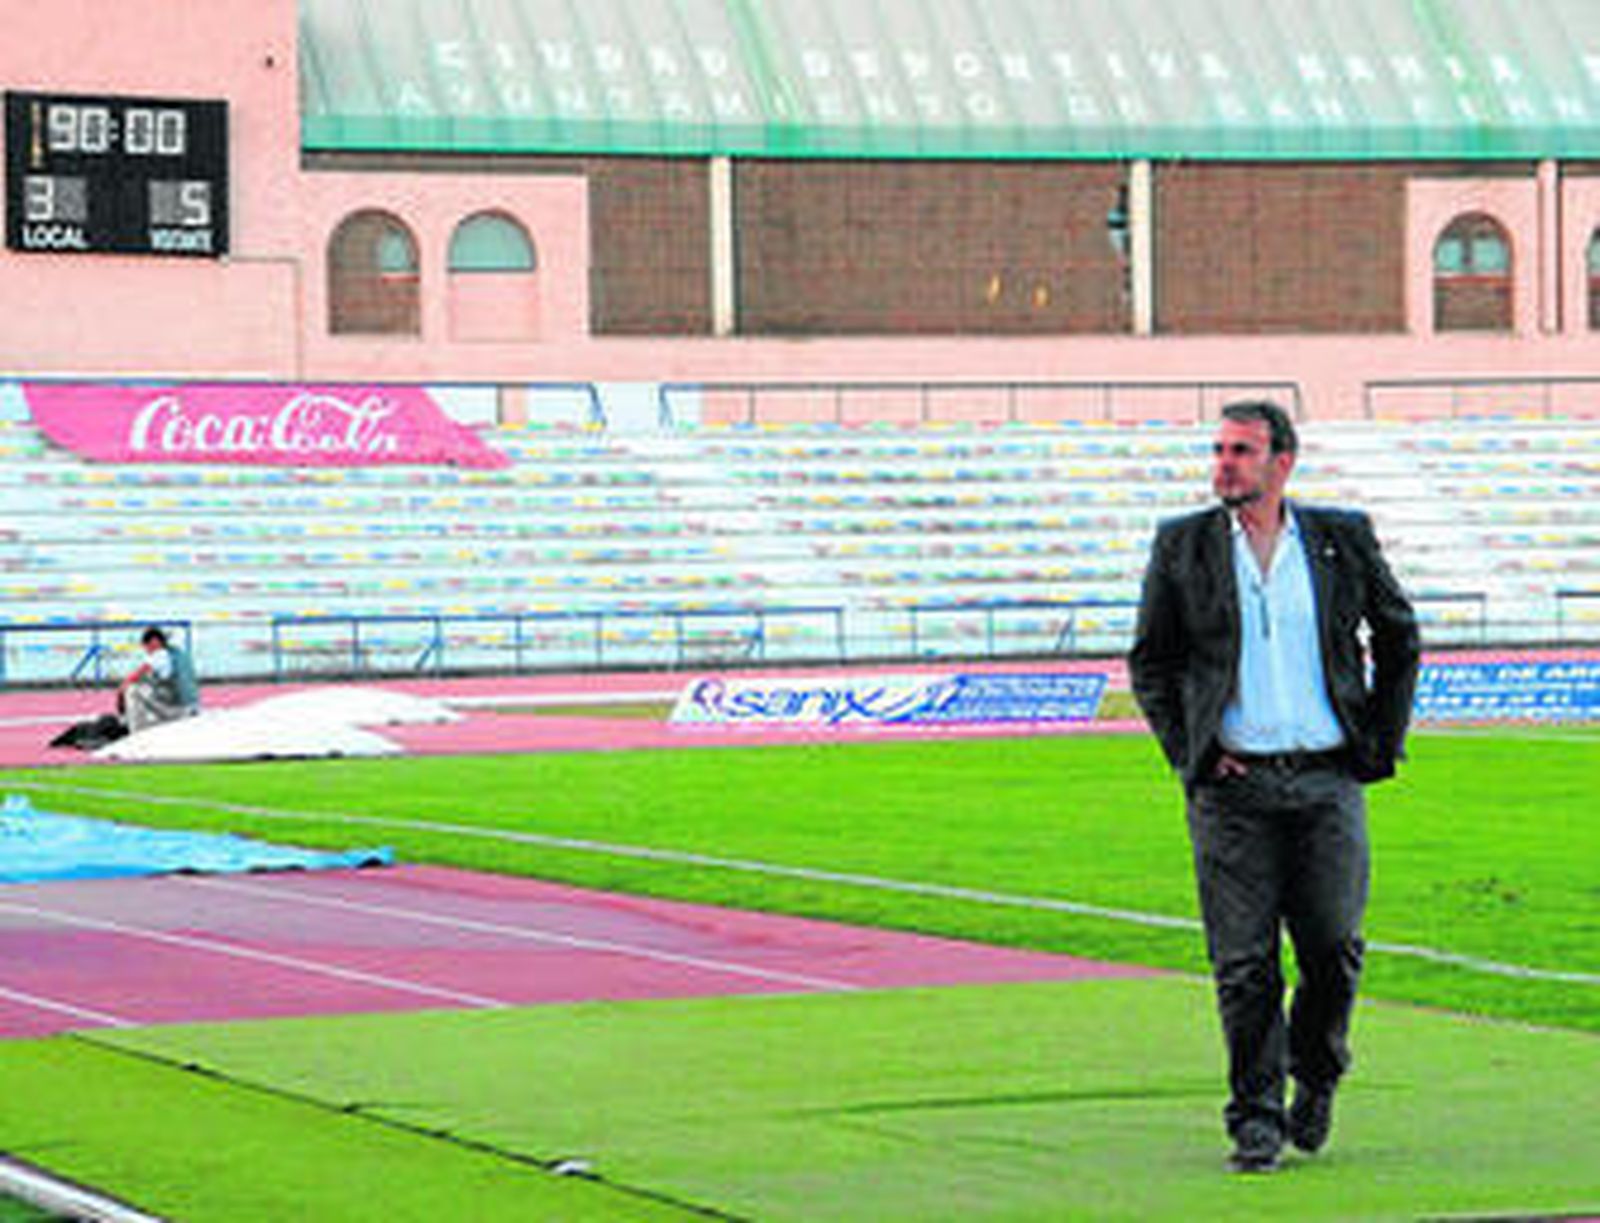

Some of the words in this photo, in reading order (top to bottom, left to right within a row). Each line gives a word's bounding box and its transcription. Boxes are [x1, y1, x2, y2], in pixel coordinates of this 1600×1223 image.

[48, 106, 185, 155] 90:00
[27, 176, 54, 221] 3
[180, 181, 210, 226] 5
[23, 226, 89, 249] LOCAL
